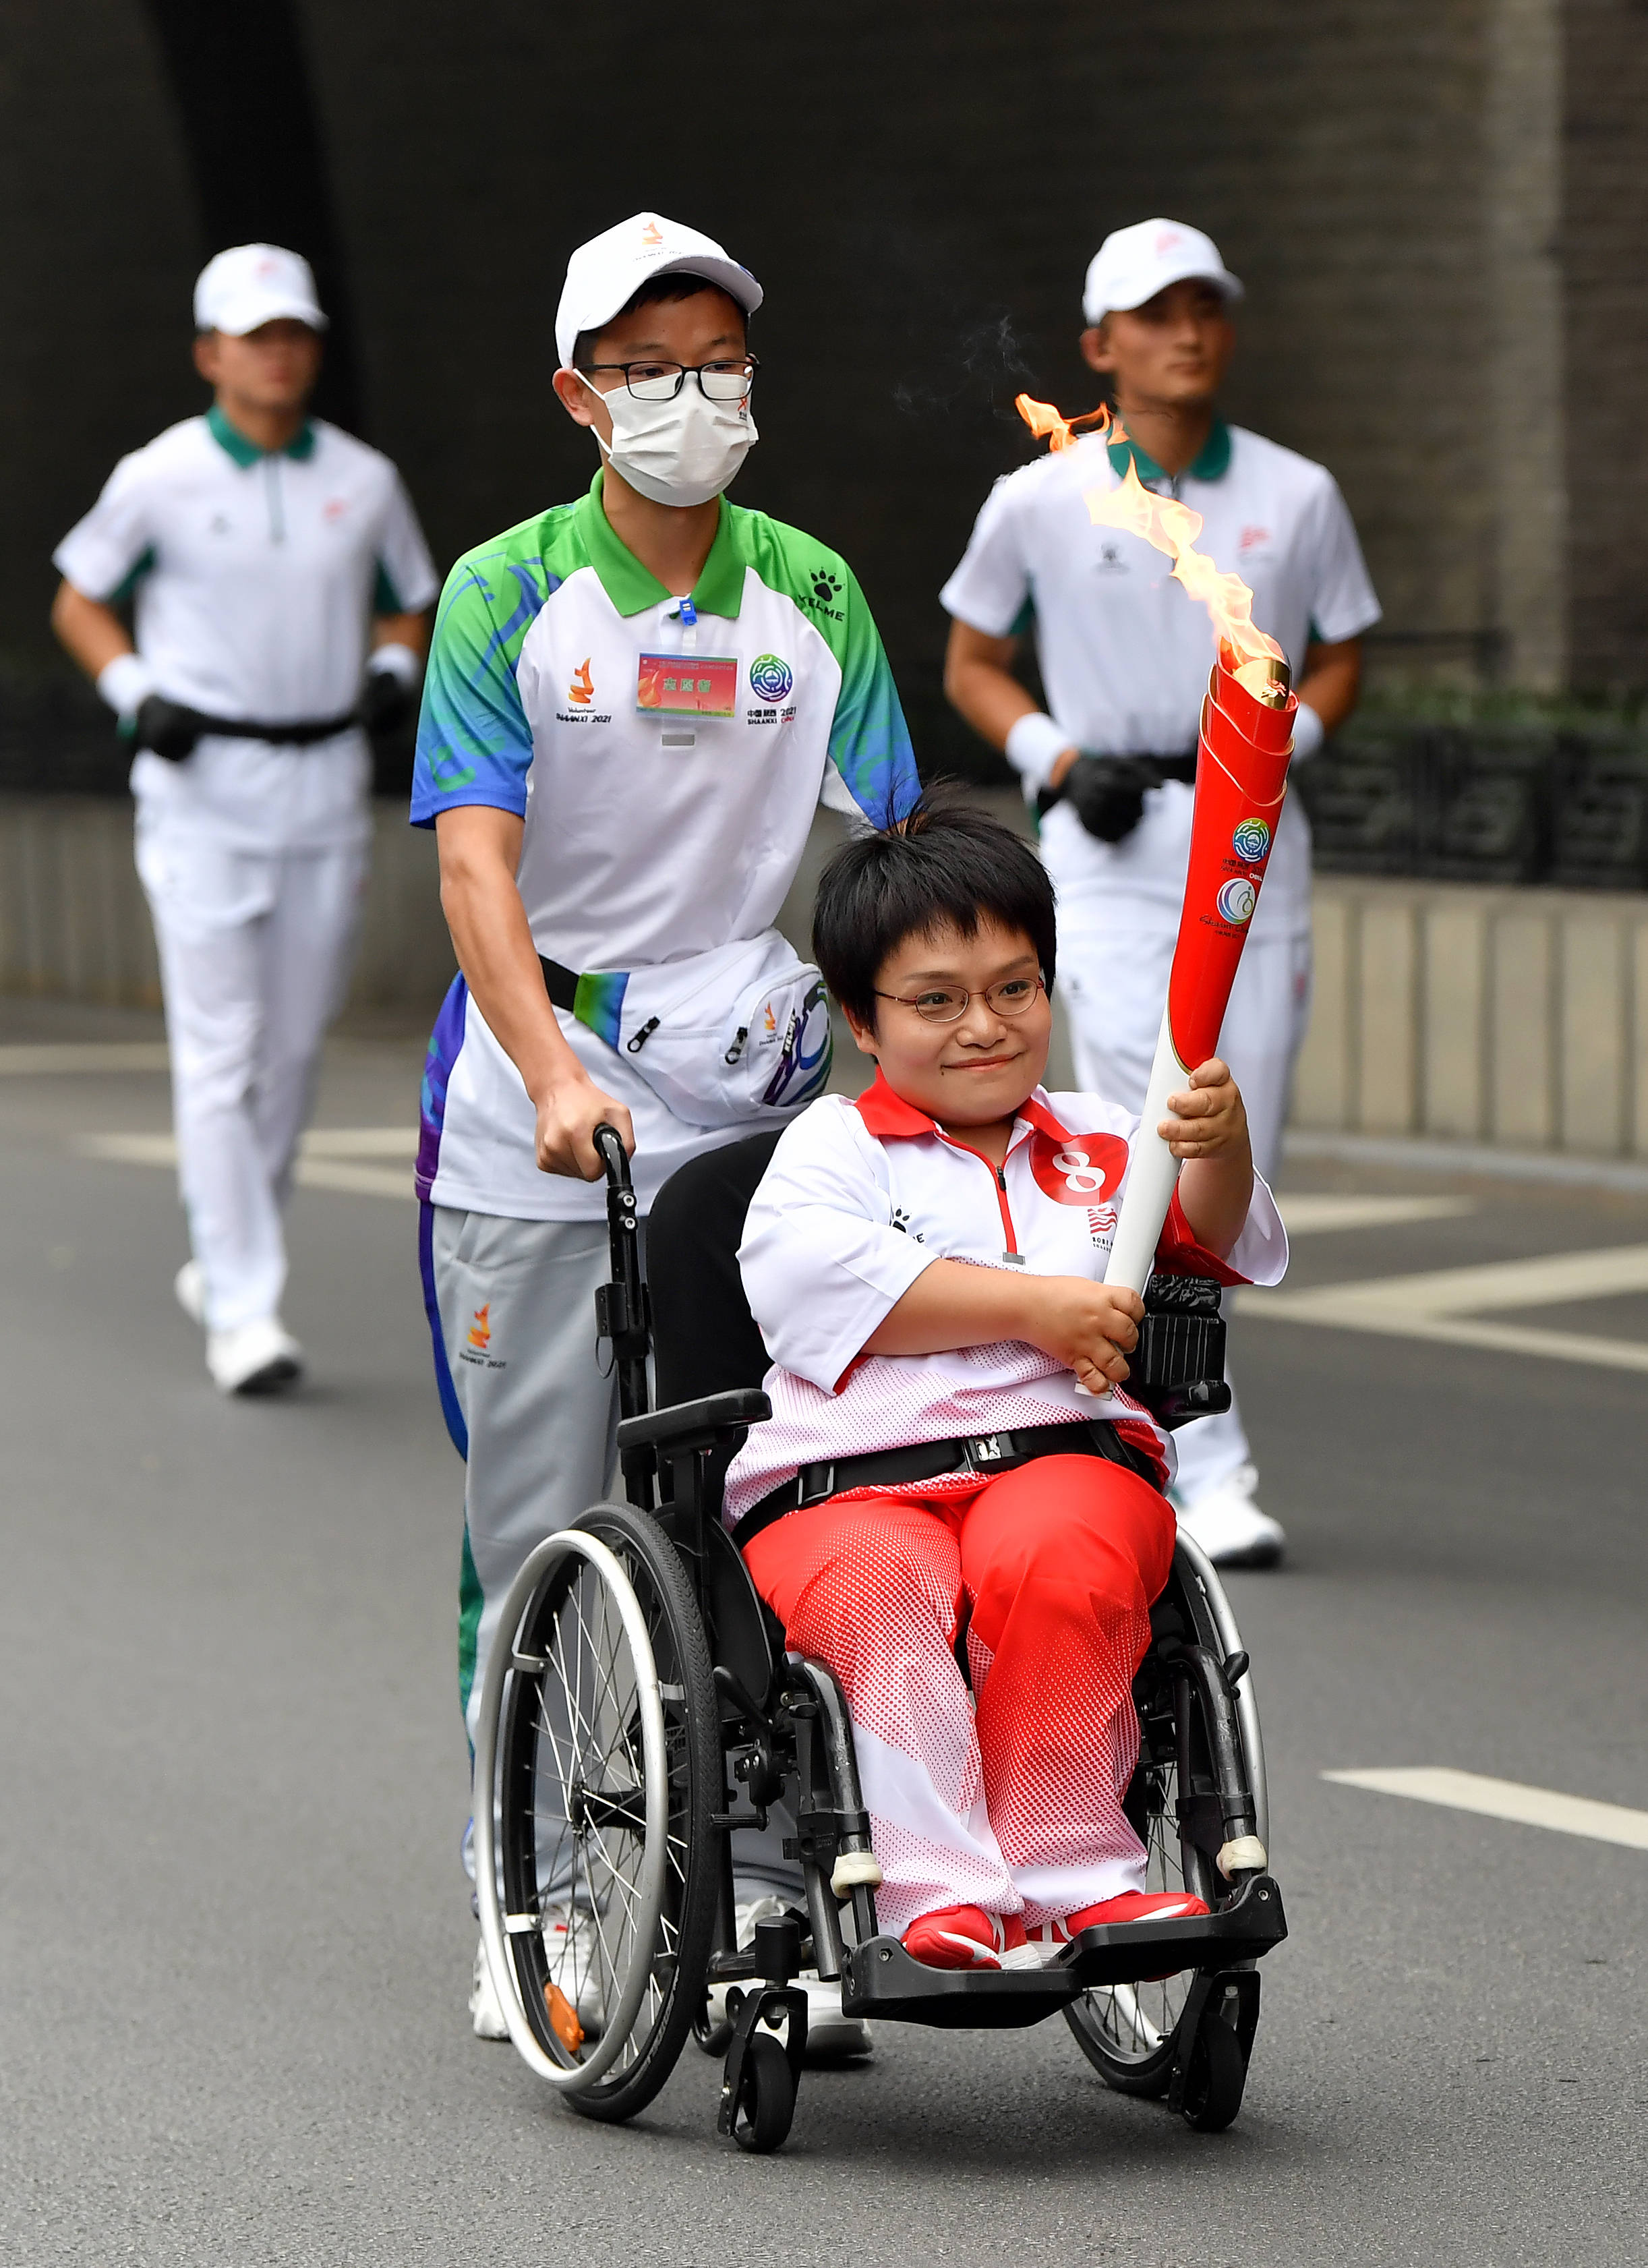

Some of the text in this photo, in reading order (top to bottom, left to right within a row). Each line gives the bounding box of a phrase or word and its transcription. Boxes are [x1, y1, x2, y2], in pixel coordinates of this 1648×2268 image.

[798, 594, 845, 622] KELME
[591, 715, 612, 723] 2021
[1053, 1151, 1106, 1193] 8
